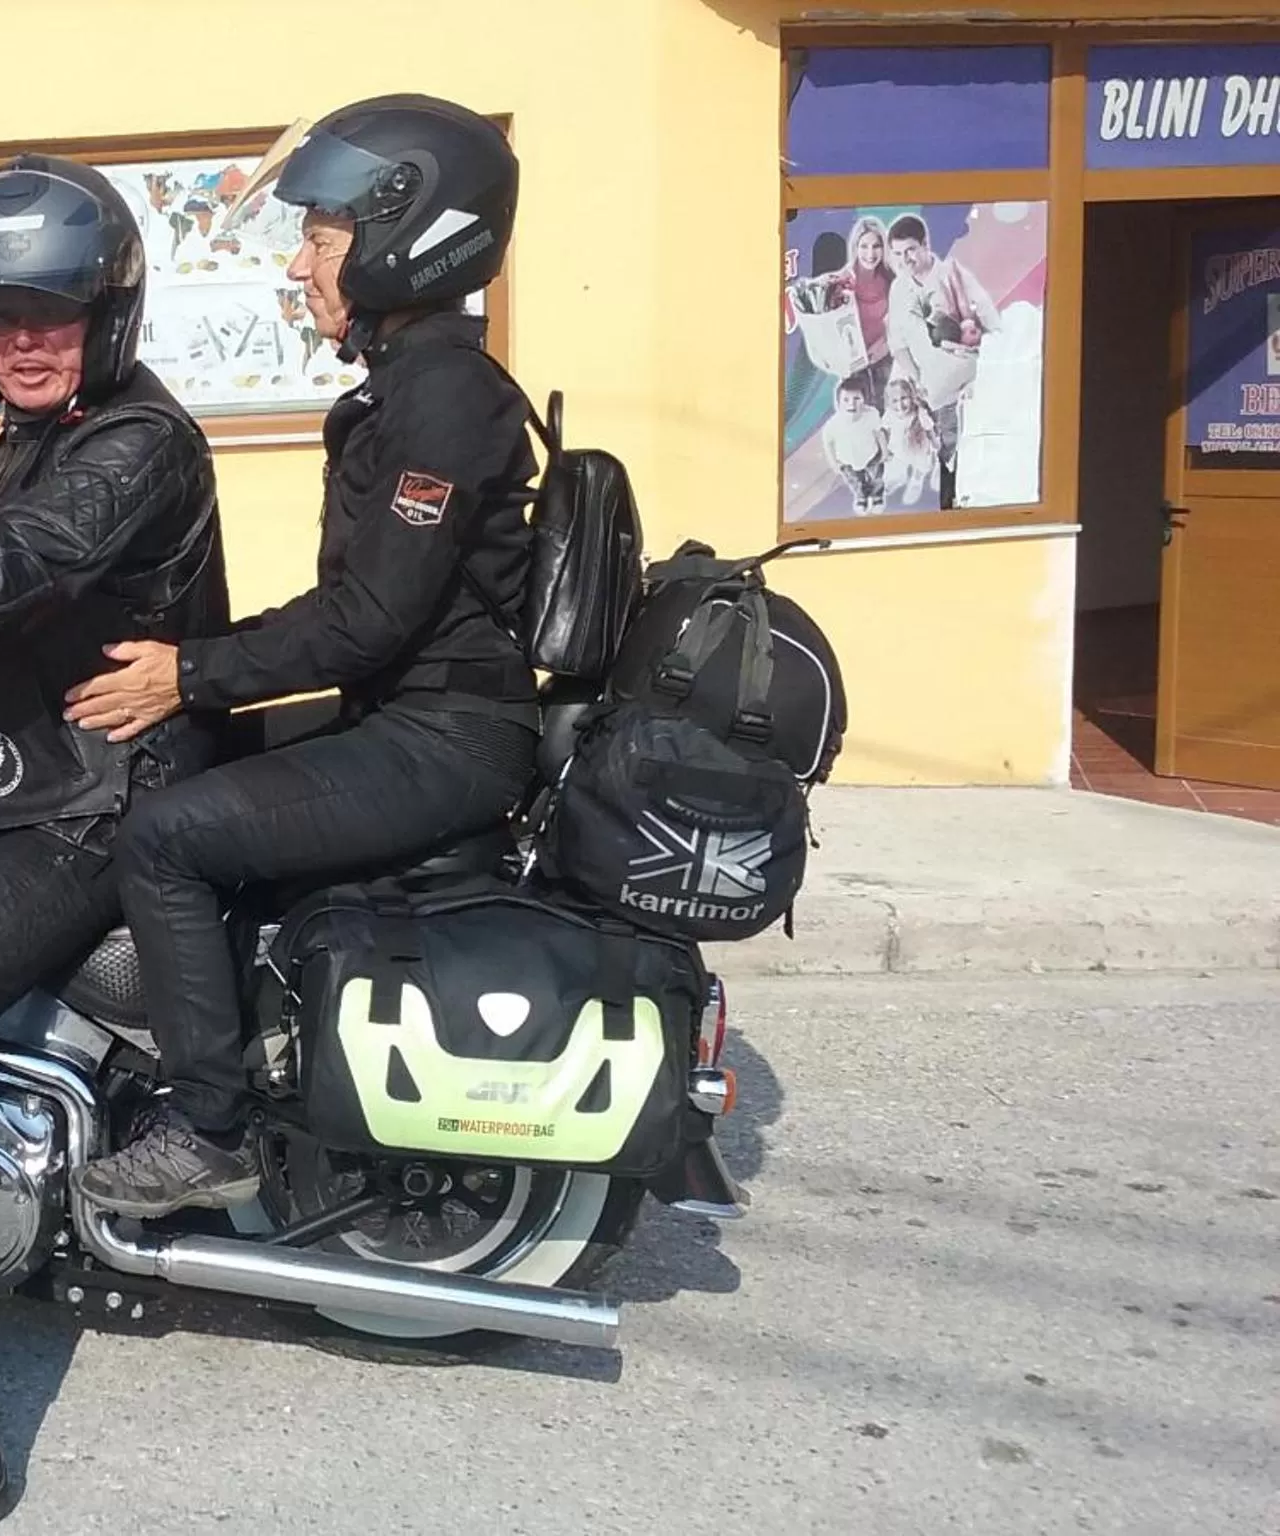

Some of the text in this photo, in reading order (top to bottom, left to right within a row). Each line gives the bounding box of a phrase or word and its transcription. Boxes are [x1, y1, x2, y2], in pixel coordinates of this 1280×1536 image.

[1099, 74, 1280, 141] BLINI DH
[410, 228, 495, 292] HARLEY-DAVIDSON
[619, 883, 765, 921] karrimor
